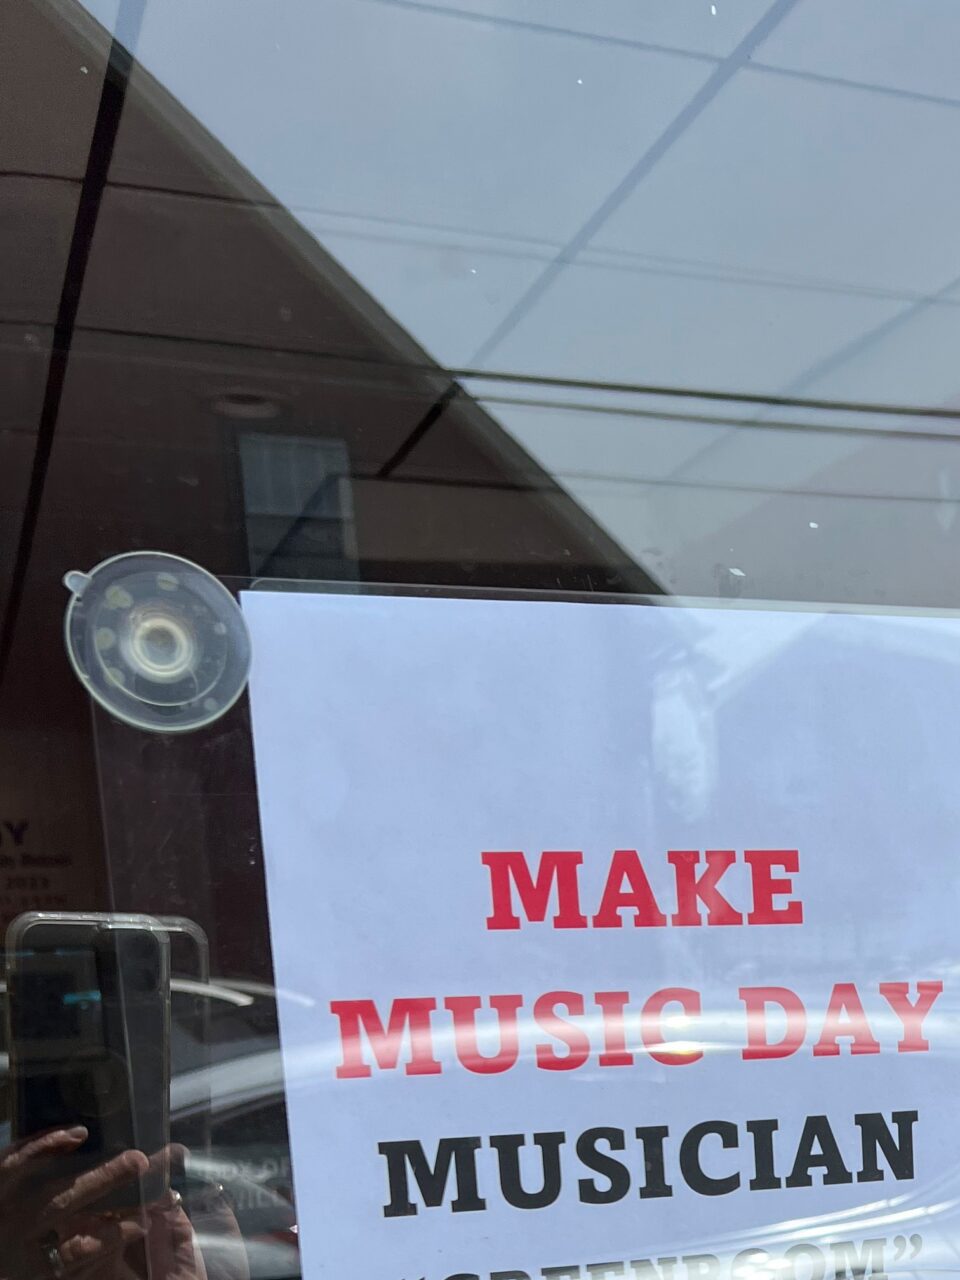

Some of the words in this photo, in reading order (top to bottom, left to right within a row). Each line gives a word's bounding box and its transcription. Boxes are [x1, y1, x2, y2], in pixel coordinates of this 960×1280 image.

[480, 849, 804, 931] MAKE
[329, 986, 705, 1079] MUSIC
[738, 980, 944, 1061] DAY
[377, 1109, 919, 1219] MUSICIAN
